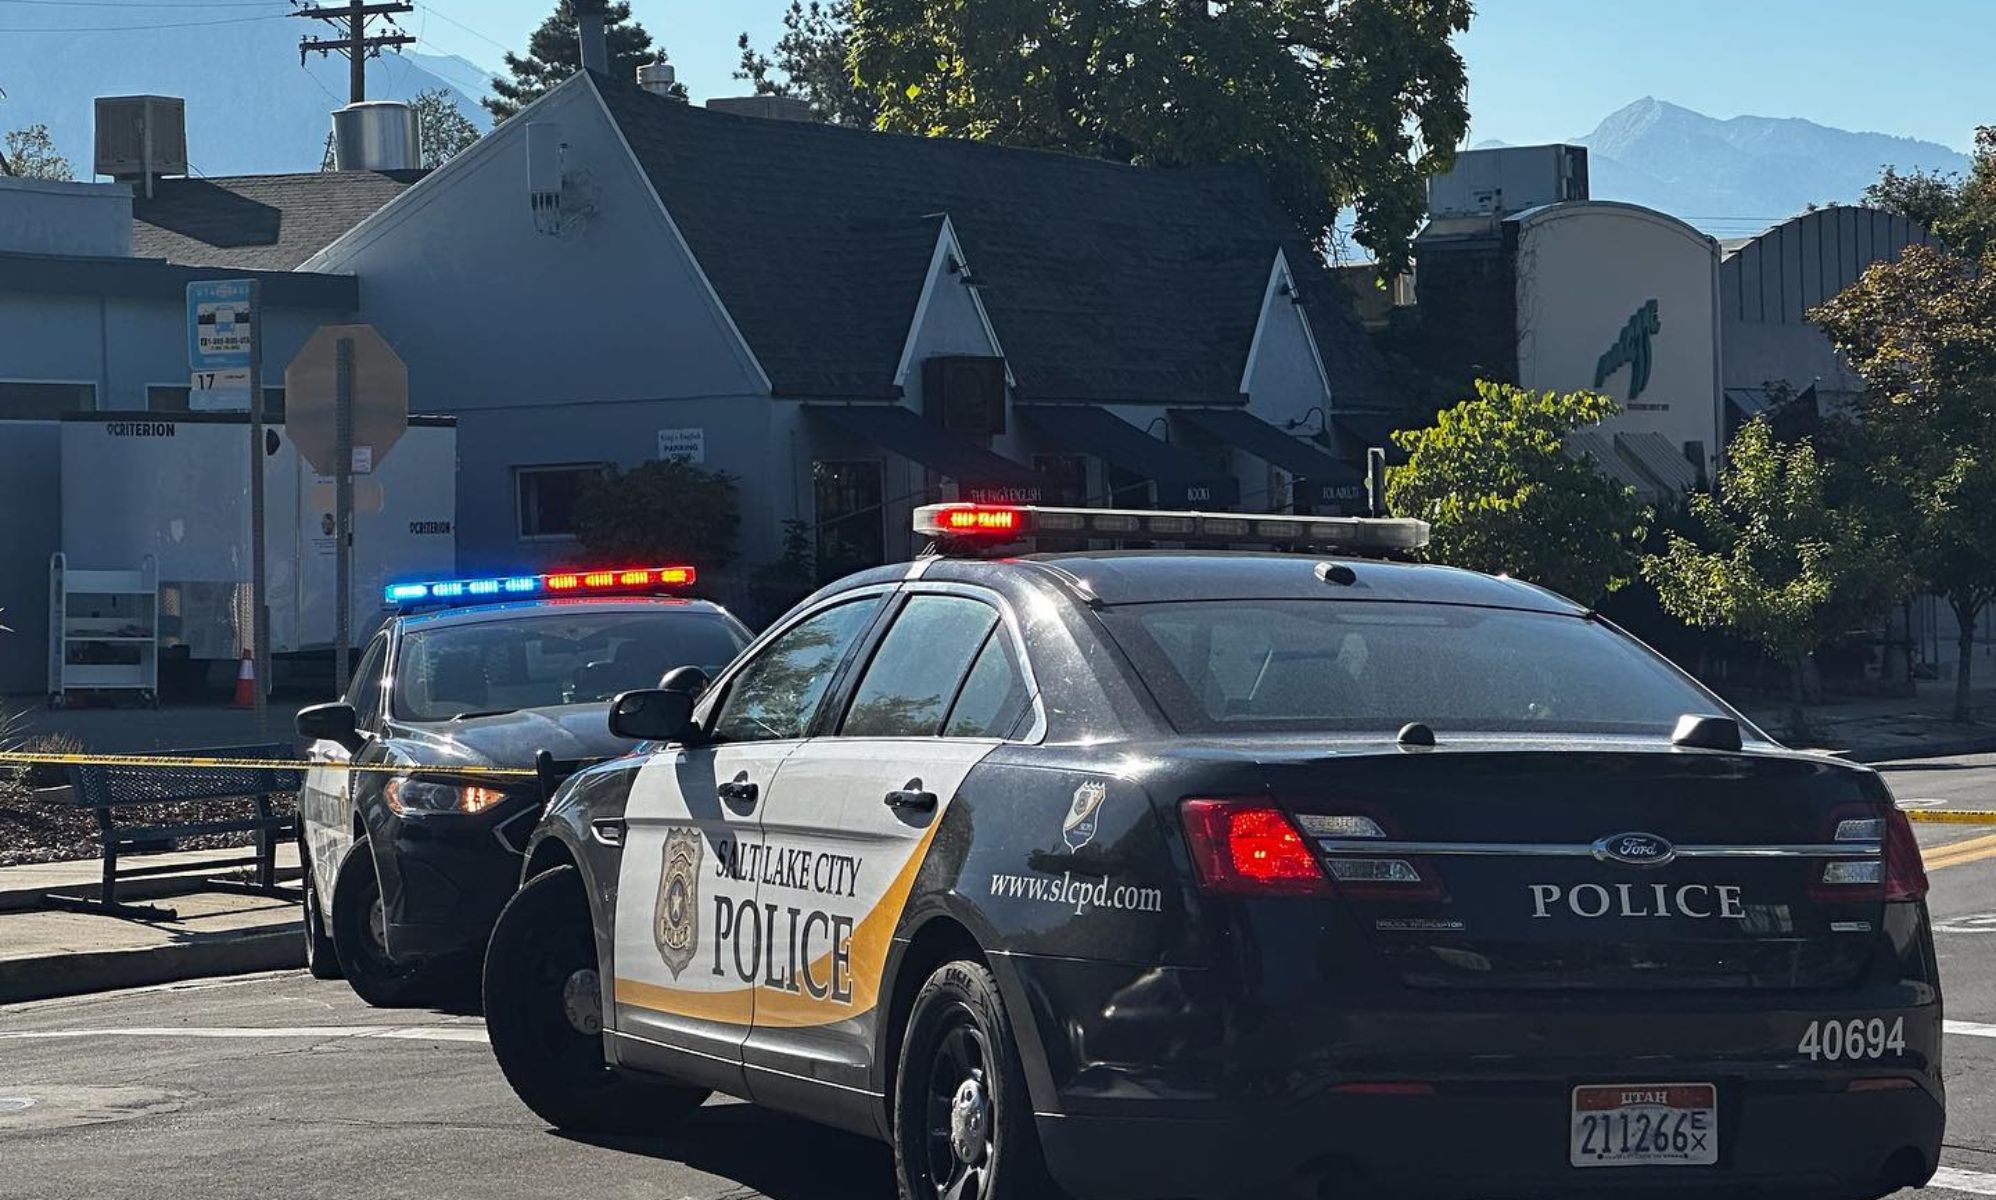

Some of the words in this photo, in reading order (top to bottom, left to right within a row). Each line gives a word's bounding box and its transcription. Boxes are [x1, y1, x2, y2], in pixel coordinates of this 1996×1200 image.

[198, 373, 216, 390] 17
[114, 423, 176, 437] CRITERION
[415, 521, 451, 534] CRITERION
[1619, 837, 1657, 856] Ford
[715, 840, 762, 882] SALT
[761, 845, 813, 891] LAKE
[814, 852, 863, 898] CITY
[990, 871, 1163, 916] www.slcpd.com
[1528, 883, 1747, 919] POLICE
[712, 895, 854, 1004] POLICE
[1798, 1016, 1906, 1061] 40694
[1621, 1091, 1669, 1105] UTAH
[1581, 1112, 1688, 1155] 211266
